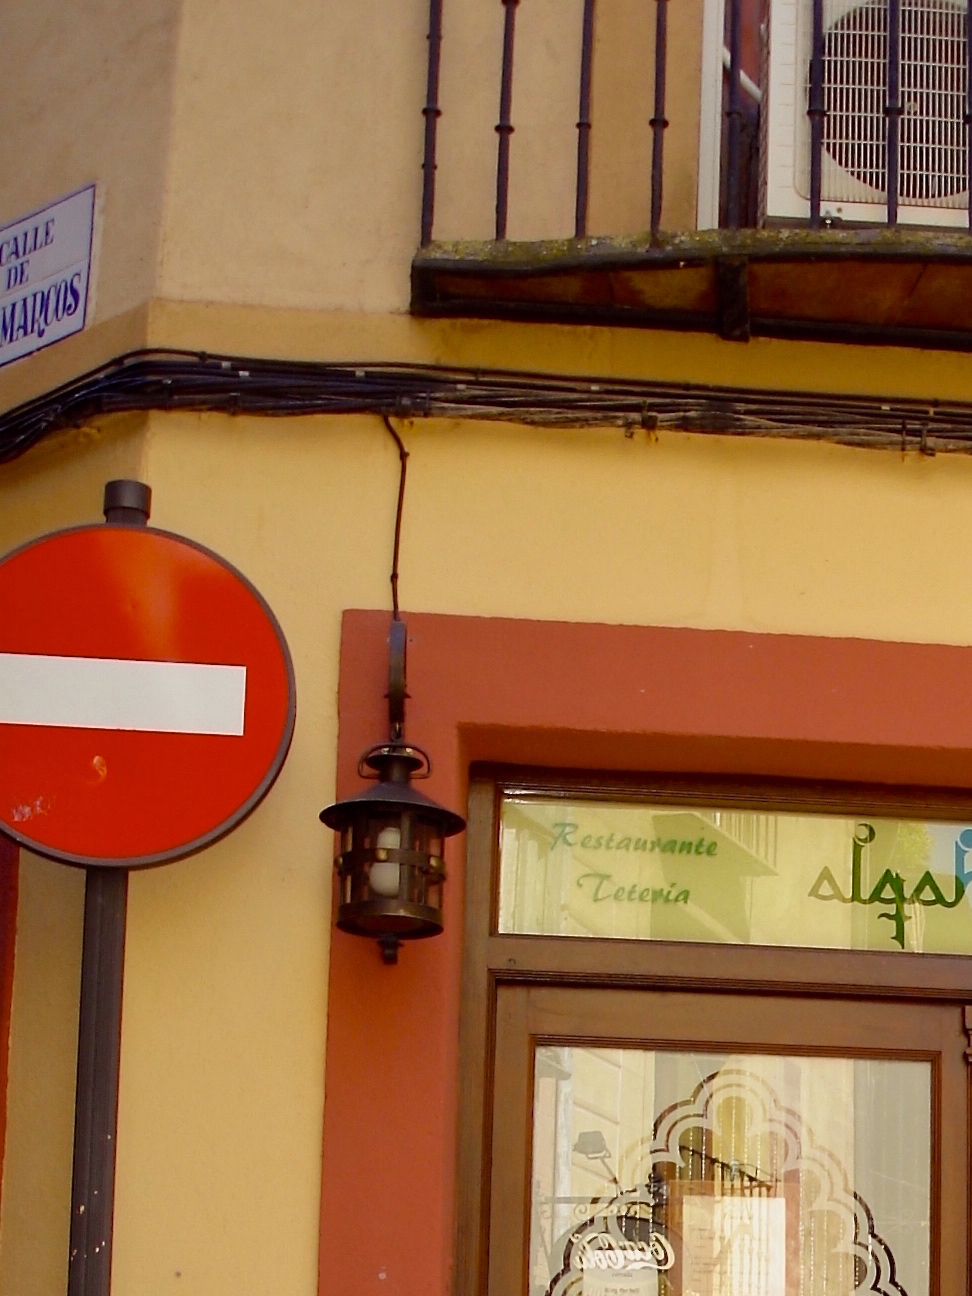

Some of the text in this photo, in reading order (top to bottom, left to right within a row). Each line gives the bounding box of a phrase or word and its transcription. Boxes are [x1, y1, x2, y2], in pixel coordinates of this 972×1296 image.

[0, 218, 55, 267] CALLE
[6, 260, 30, 292] DE
[0, 272, 81, 347] MARCOS
[549, 821, 718, 858] Restaurante
